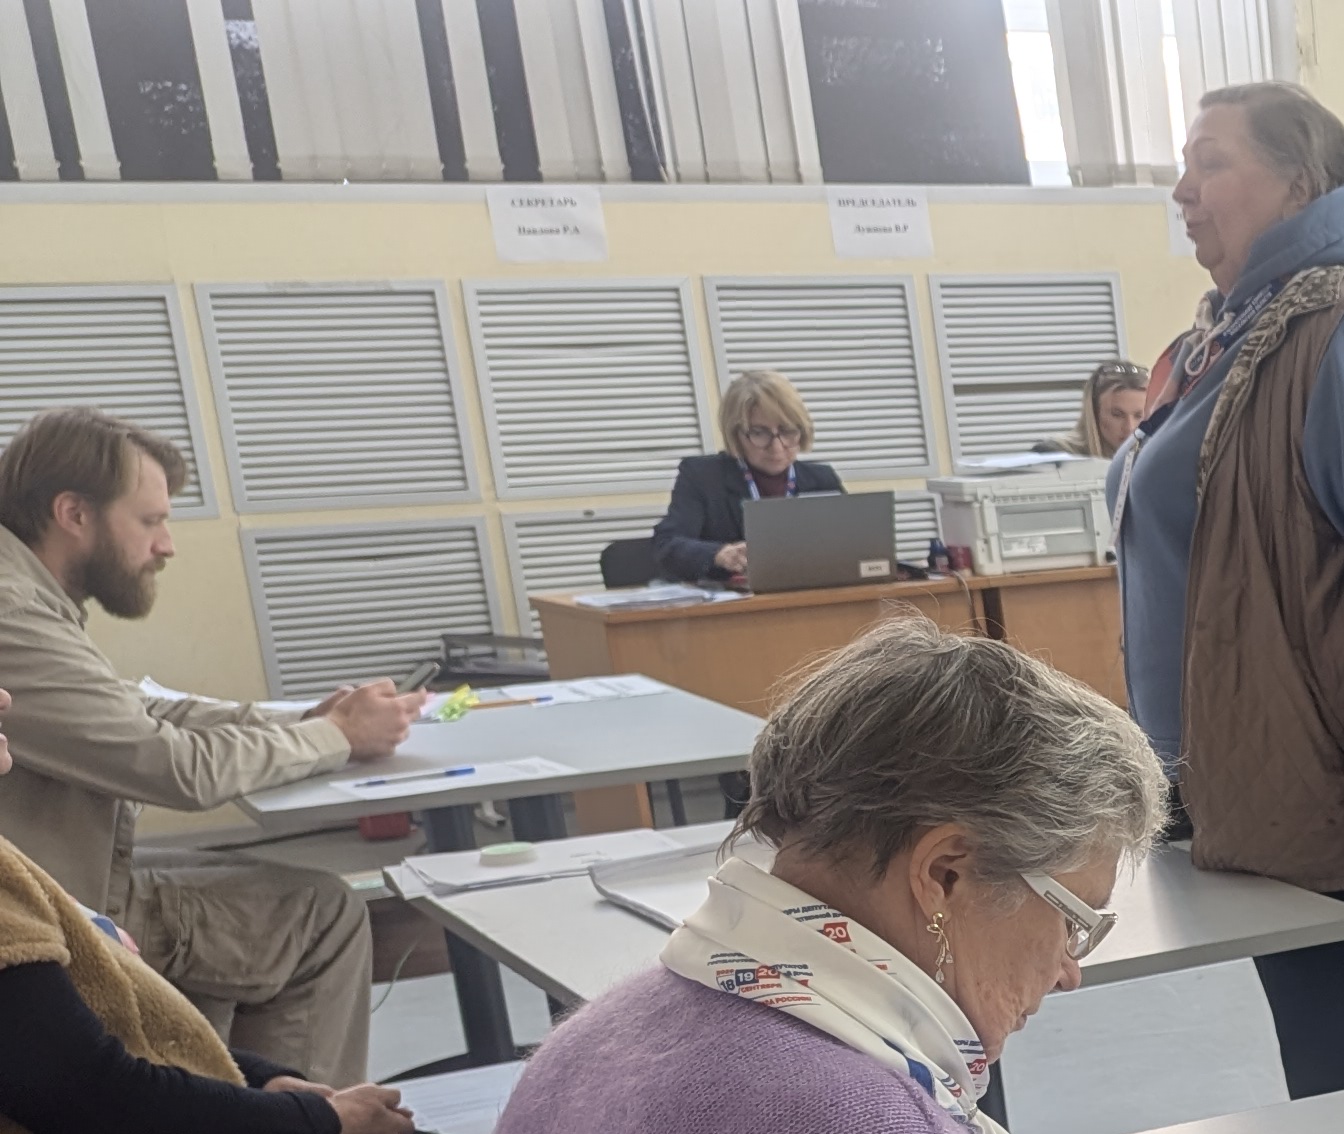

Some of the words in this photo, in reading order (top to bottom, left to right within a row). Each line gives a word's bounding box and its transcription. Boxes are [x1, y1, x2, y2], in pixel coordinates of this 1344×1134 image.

[510, 196, 577, 208] СЕКРЕТАРЬ
[824, 926, 848, 940] 20
[720, 979, 736, 993] 18
[737, 971, 755, 982] 19
